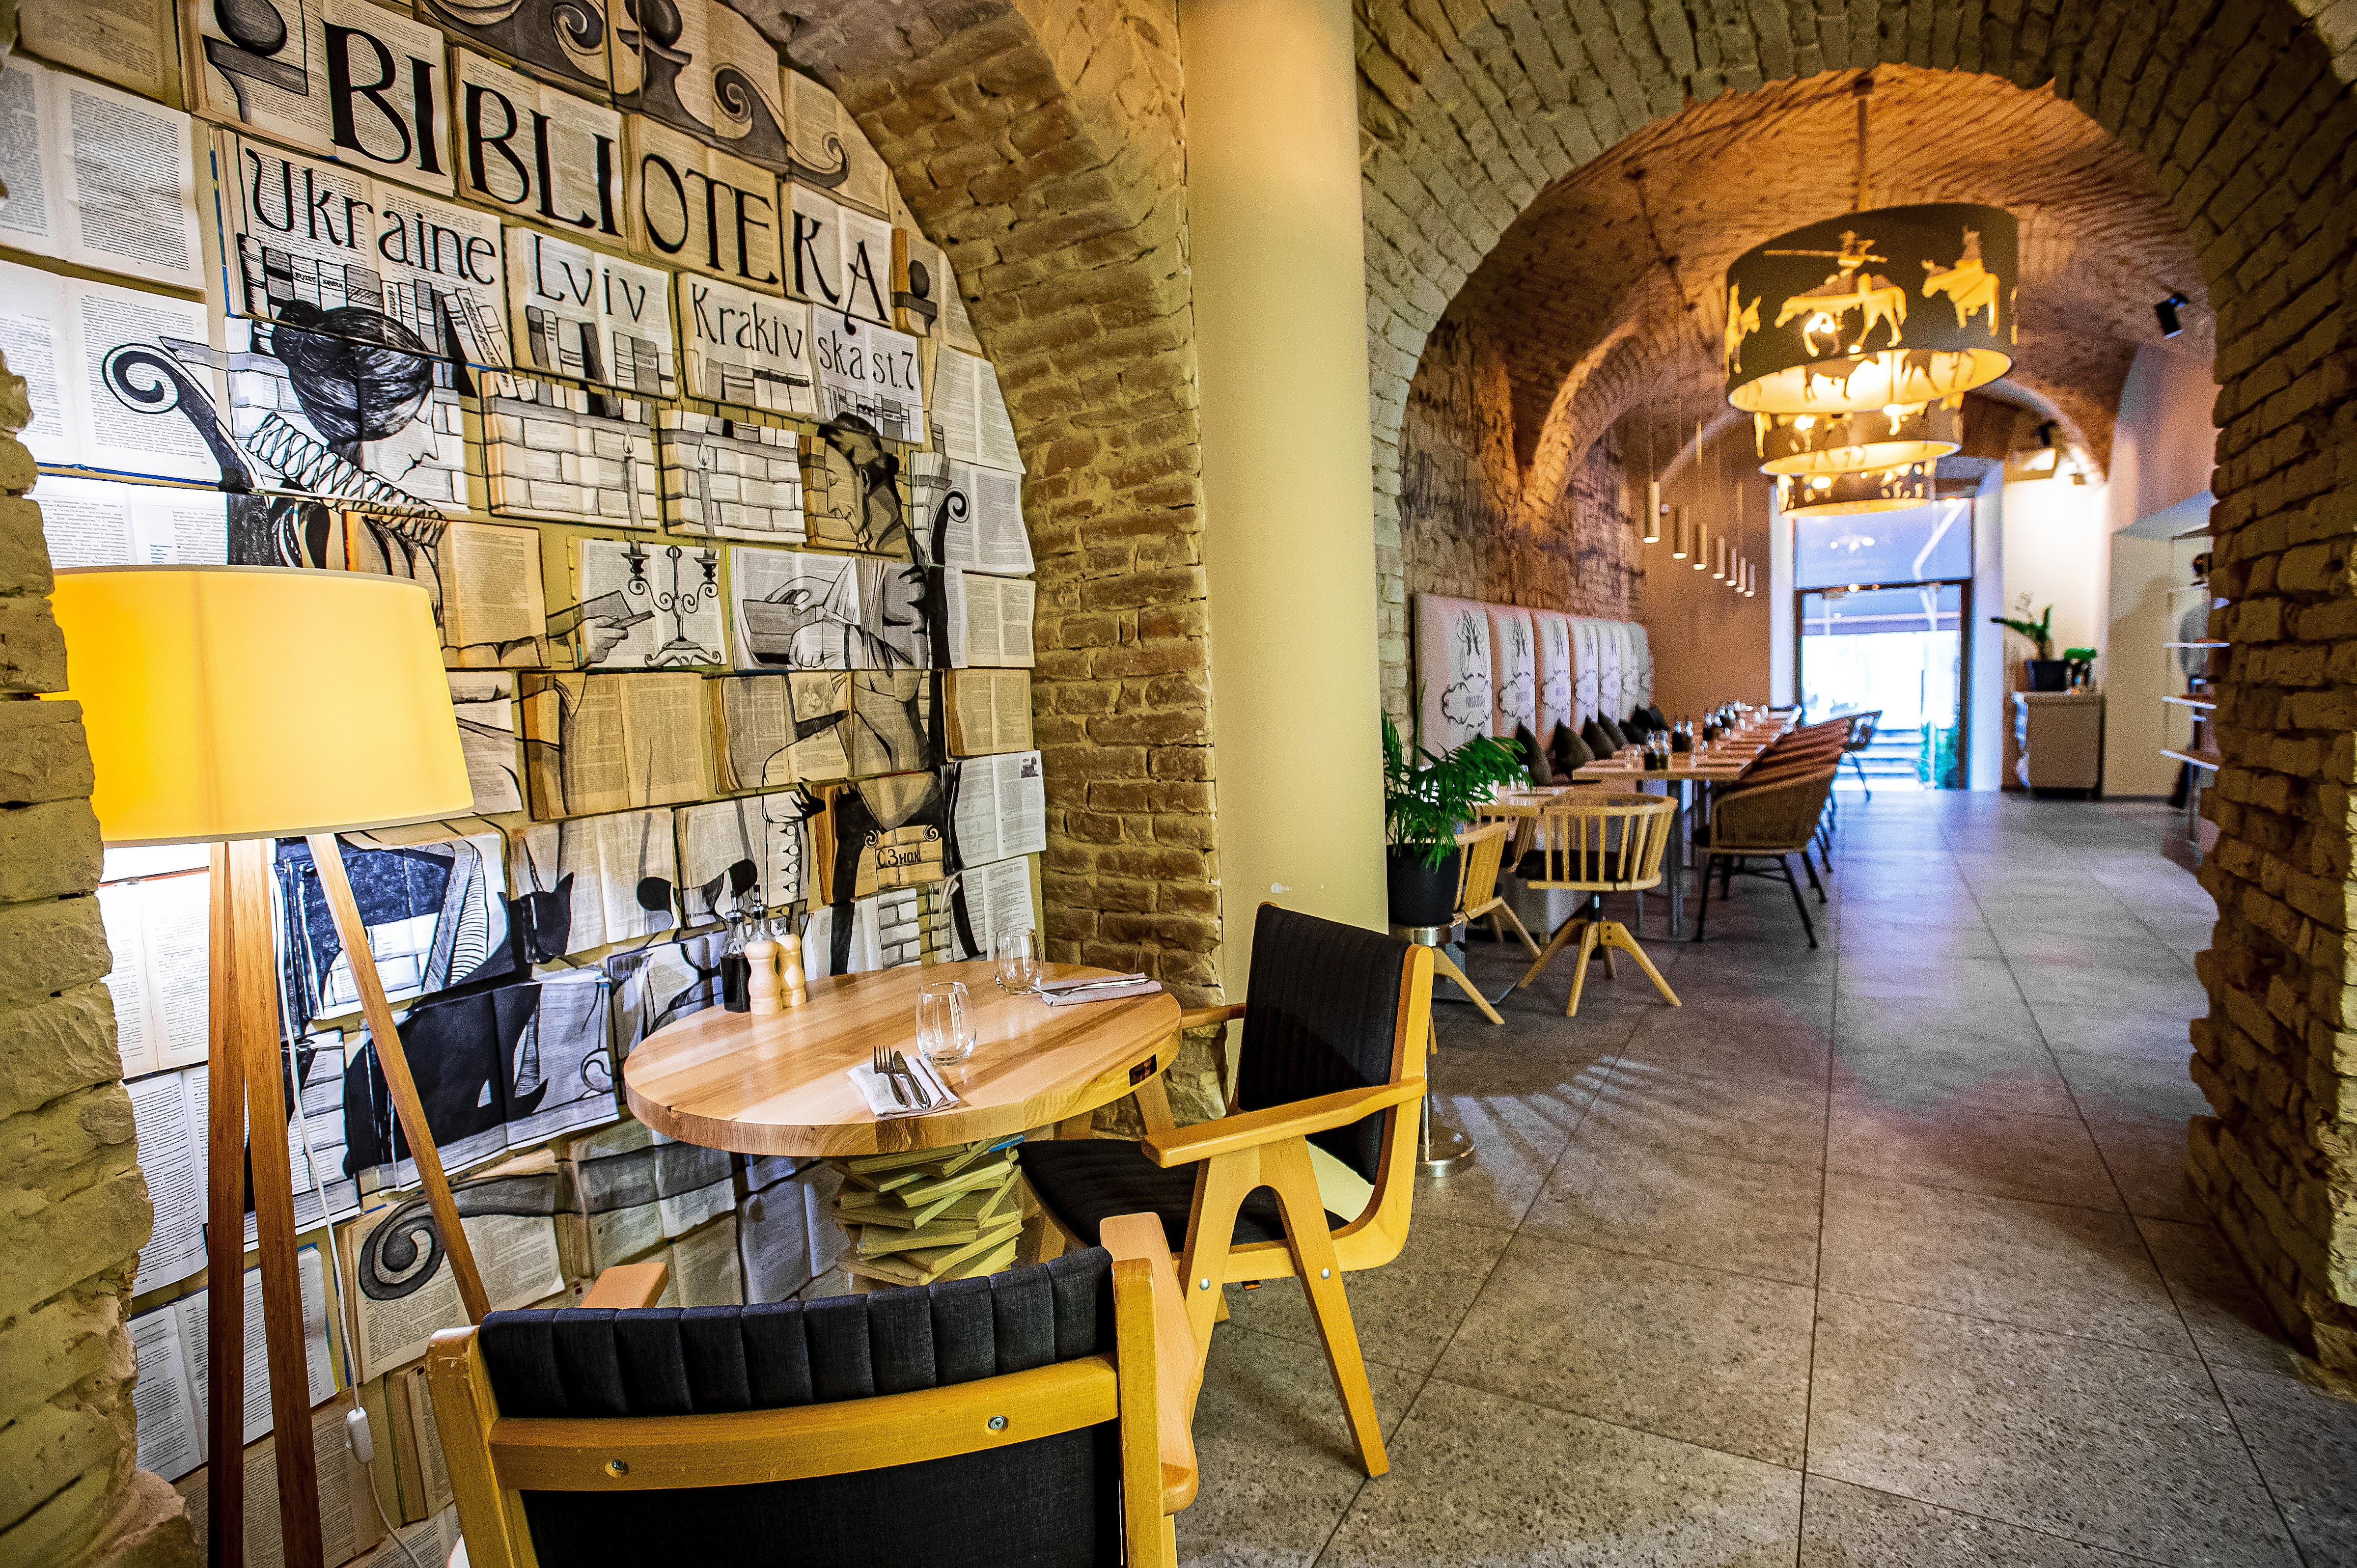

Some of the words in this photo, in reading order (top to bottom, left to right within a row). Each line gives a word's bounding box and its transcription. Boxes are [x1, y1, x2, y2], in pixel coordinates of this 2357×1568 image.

[246, 147, 496, 285] Ukraine
[532, 233, 646, 323] Lviv
[319, 17, 891, 336] BIBLIOTEKA
